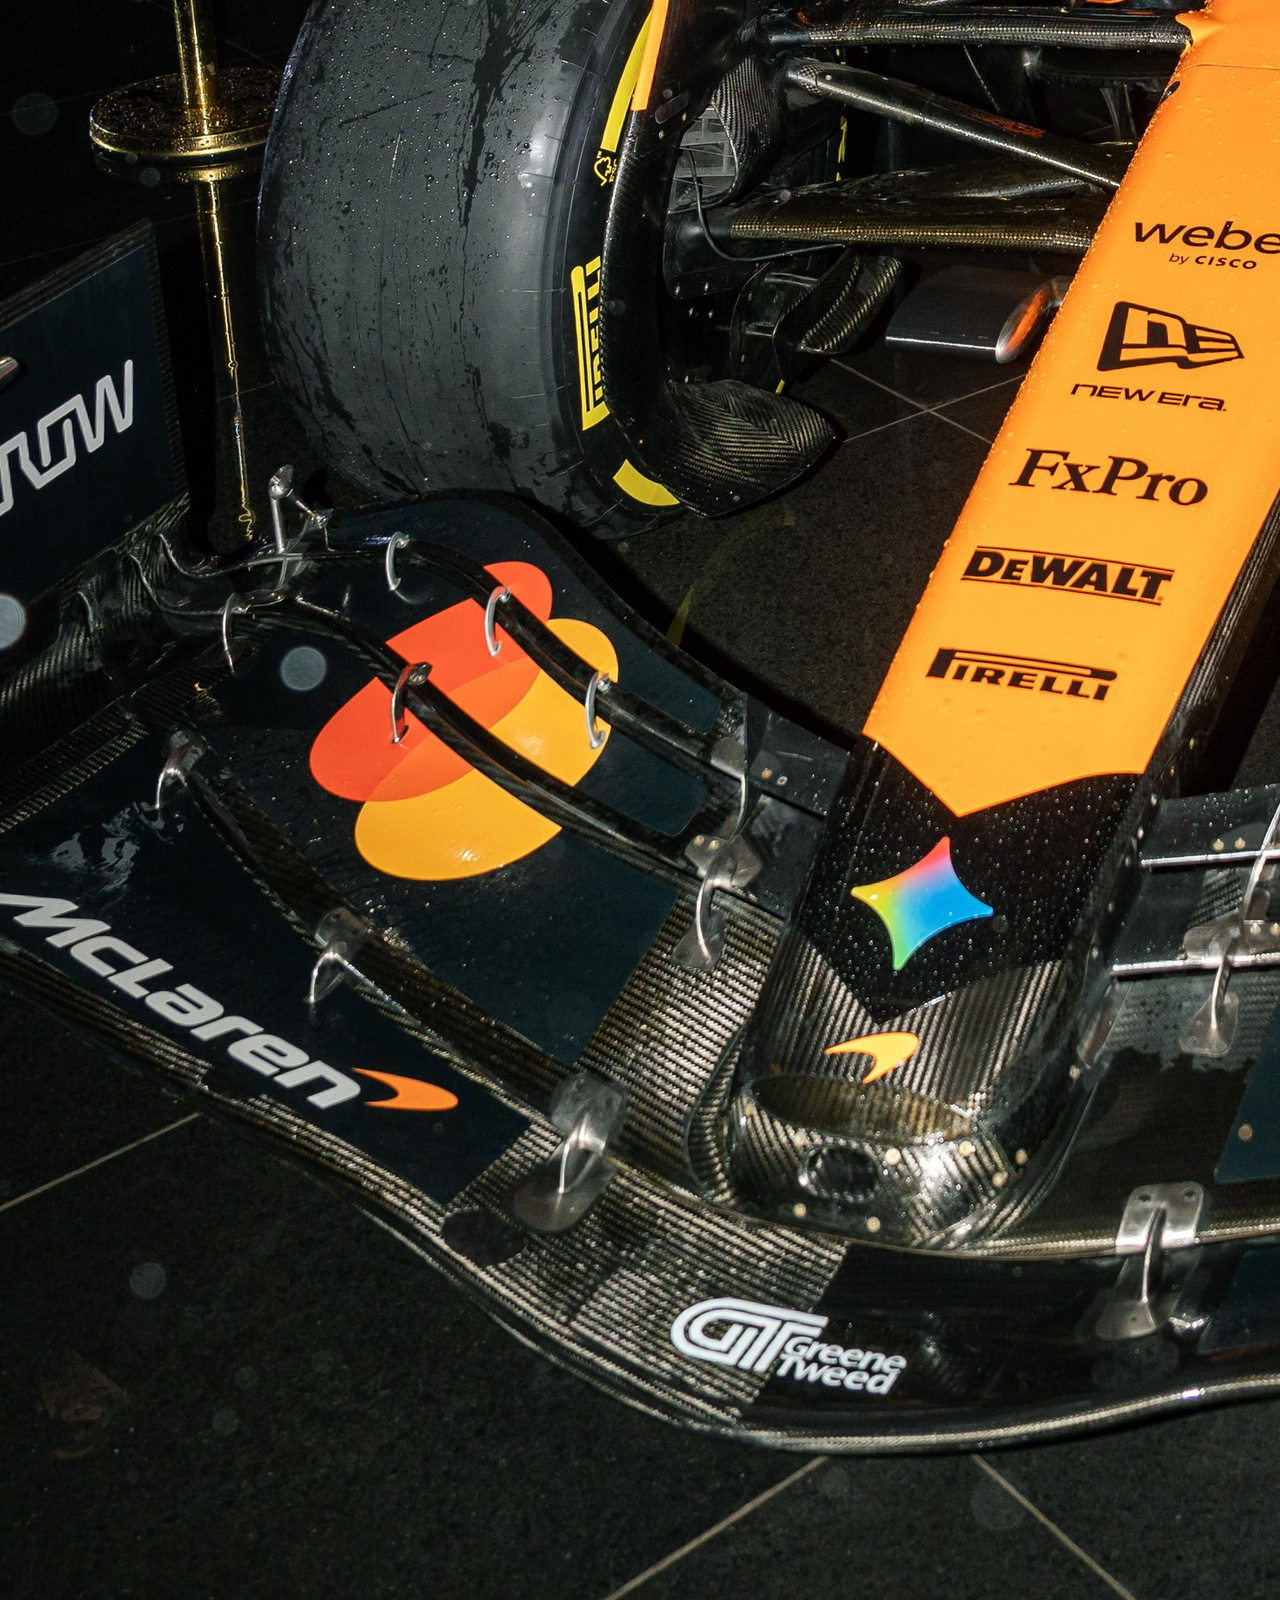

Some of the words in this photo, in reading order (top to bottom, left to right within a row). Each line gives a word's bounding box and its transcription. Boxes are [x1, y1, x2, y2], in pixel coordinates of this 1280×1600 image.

[1168, 252, 1191, 266] by
[1008, 447, 1209, 507] FxPro
[925, 647, 1119, 702] PIRELLI
[0, 892, 362, 1110] McLaren
[776, 1352, 901, 1396] Tweed
[783, 1335, 908, 1374] Greene
